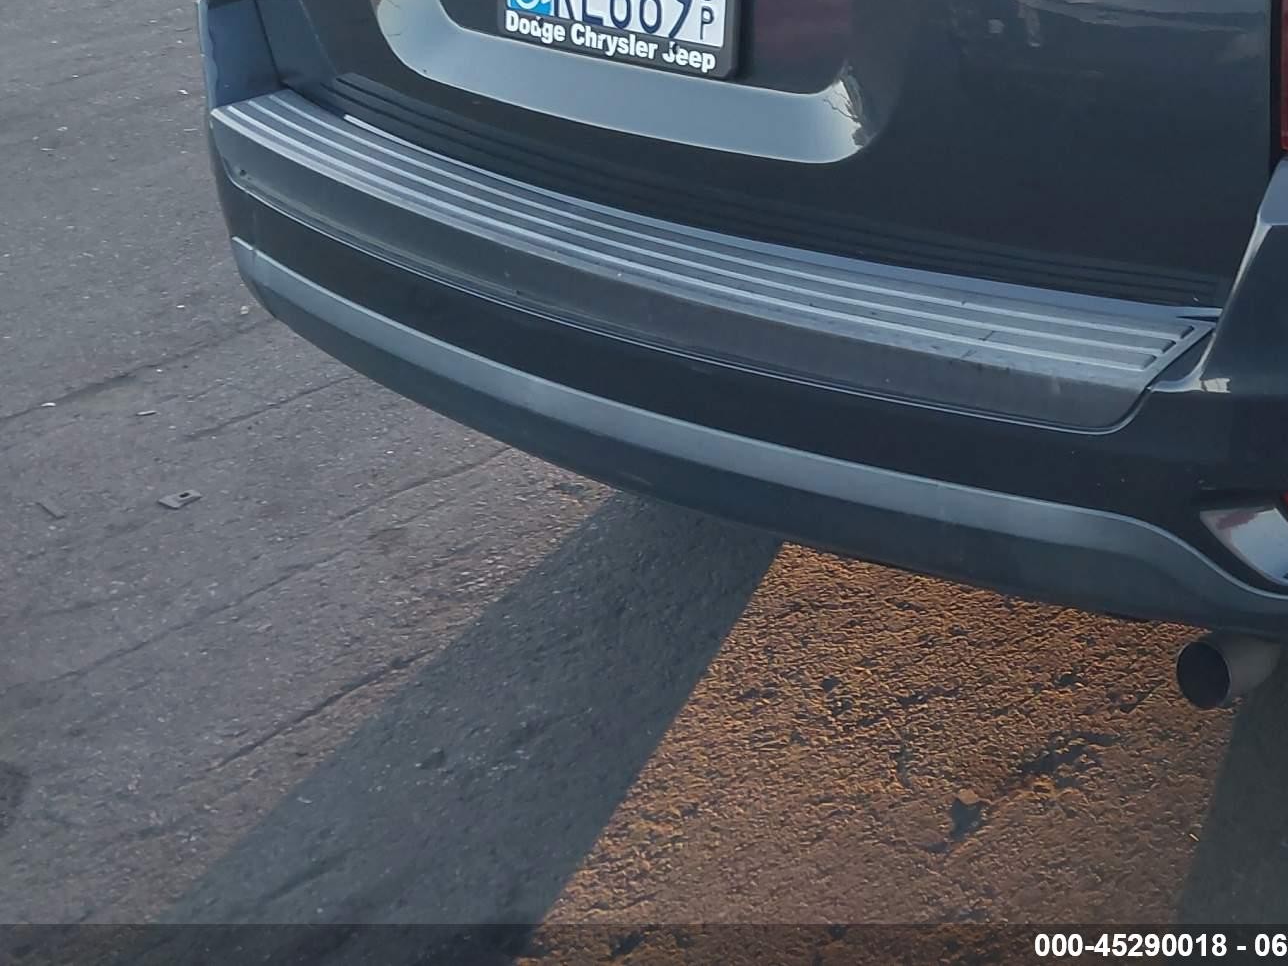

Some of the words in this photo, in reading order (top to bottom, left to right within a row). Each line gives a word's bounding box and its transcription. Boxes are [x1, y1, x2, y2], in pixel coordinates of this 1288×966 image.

[505, 10, 566, 47] Dodge
[570, 22, 658, 60] Chrysler
[662, 39, 716, 73] Jeep
